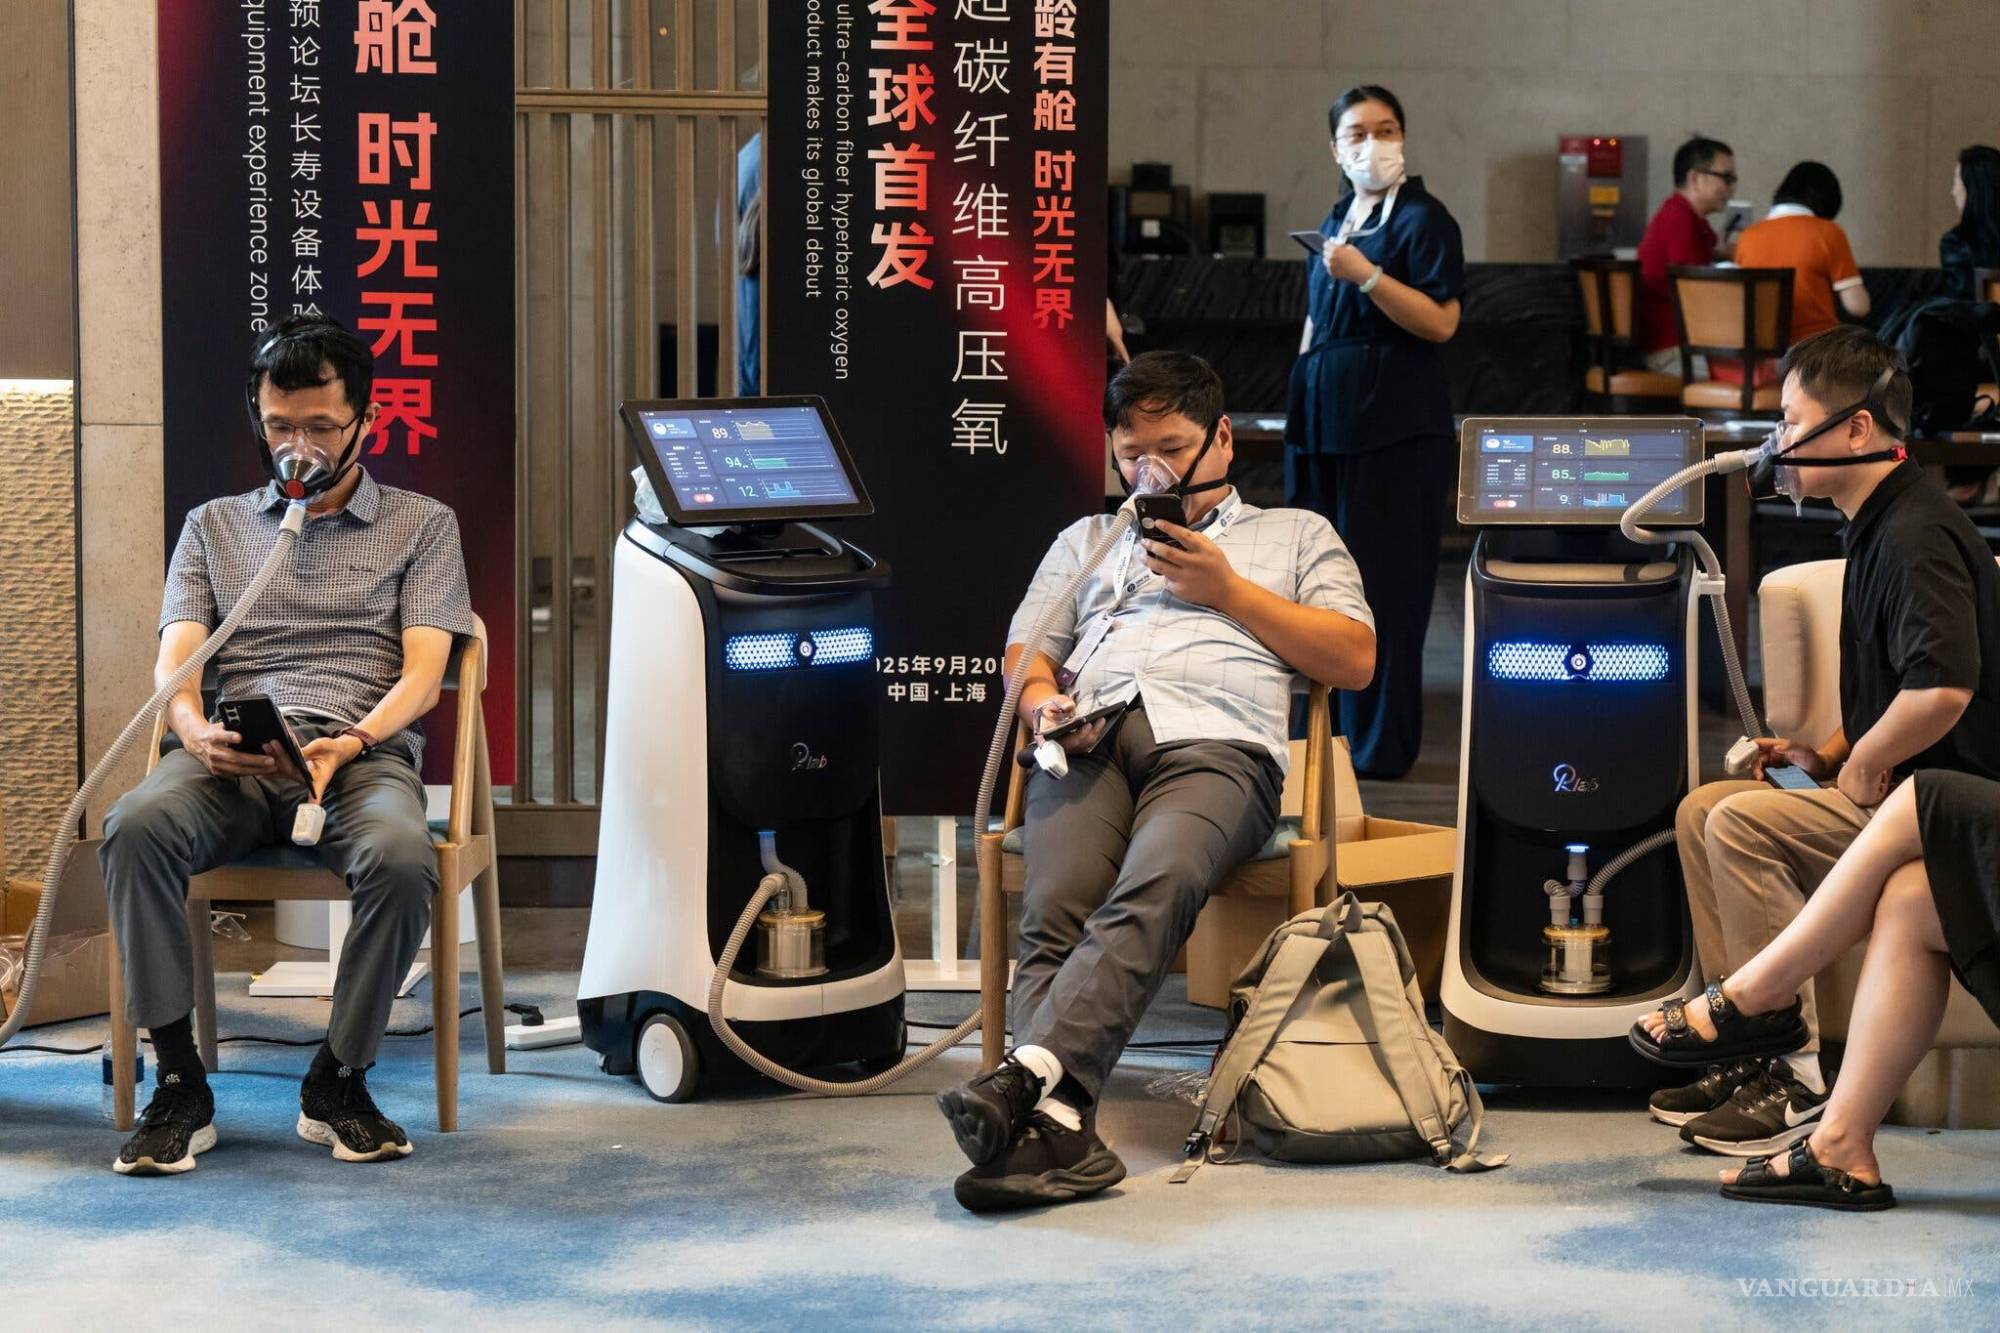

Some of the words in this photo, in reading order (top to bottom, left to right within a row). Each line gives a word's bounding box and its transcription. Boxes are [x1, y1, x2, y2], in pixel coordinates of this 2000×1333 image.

[354, 0, 437, 74] 舱
[807, 0, 824, 58] oduct
[807, 66, 824, 129] makes
[836, 4, 854, 131] ultra-carbon
[1033, 0, 1076, 131] 龄有舱
[807, 138, 823, 160] its
[836, 140, 854, 186] fiber
[866, 0, 936, 290] 全球首发
[242, 125, 272, 264] experience
[802, 168, 824, 230] global
[806, 239, 824, 297] debut
[831, 194, 854, 300] hyperbaric
[1033, 150, 1076, 329] 时光无界
[250, 272, 268, 333] zone
[356, 113, 438, 455] 时光无界
[831, 308, 848, 379] oxygen
[876, 655, 1005, 676] 25年9月20
[888, 682, 987, 702] 中国·上海
